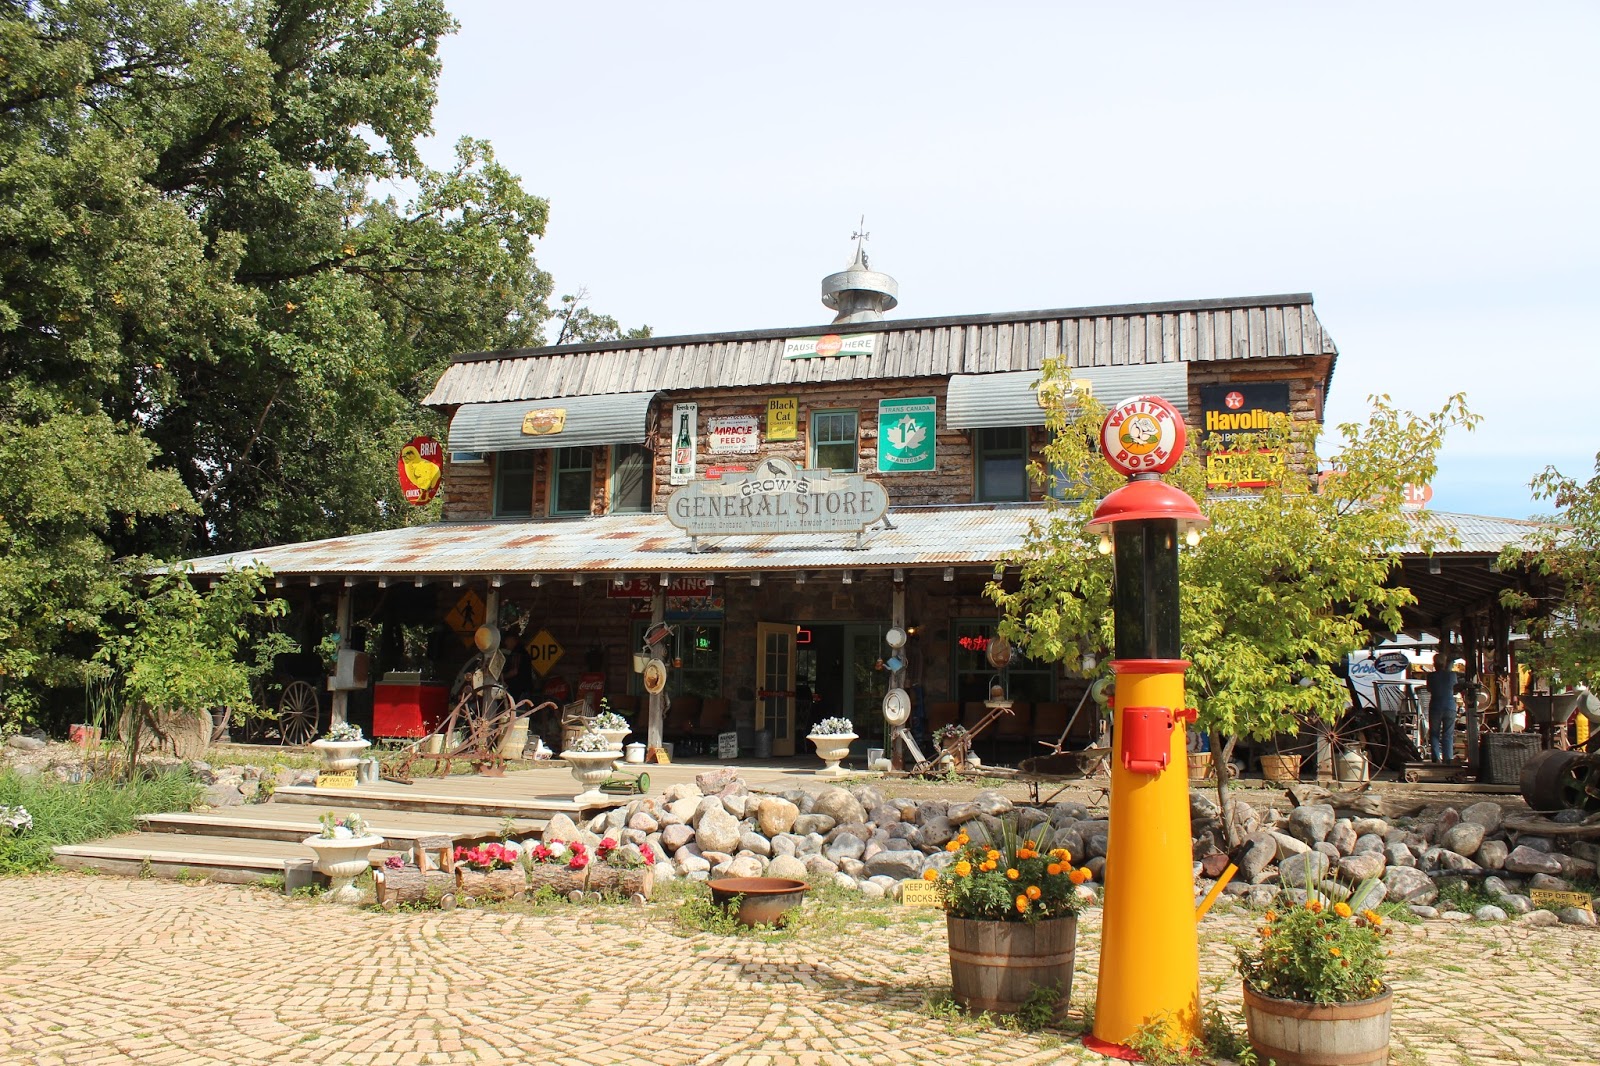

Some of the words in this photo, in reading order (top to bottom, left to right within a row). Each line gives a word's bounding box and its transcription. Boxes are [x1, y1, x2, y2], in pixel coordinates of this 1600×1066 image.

[787, 343, 814, 353] PAUSE
[844, 339, 872, 349] HERE
[770, 400, 795, 410] Black
[776, 411, 791, 421] Cat
[1110, 402, 1169, 428] WHITE
[714, 426, 753, 436] MIRACLE
[420, 442, 438, 456] BRAY
[891, 455, 922, 463] MANITOBA
[1115, 446, 1168, 468] ROSE
[741, 478, 809, 497] CROW'S
[676, 494, 788, 518] GENERAL
[795, 491, 874, 515] STORE
[530, 645, 558, 661] DIP
[579, 681, 603, 690] Coca-Cola
[904, 883, 923, 891] KEEP
[1532, 891, 1553, 899] KEEP
